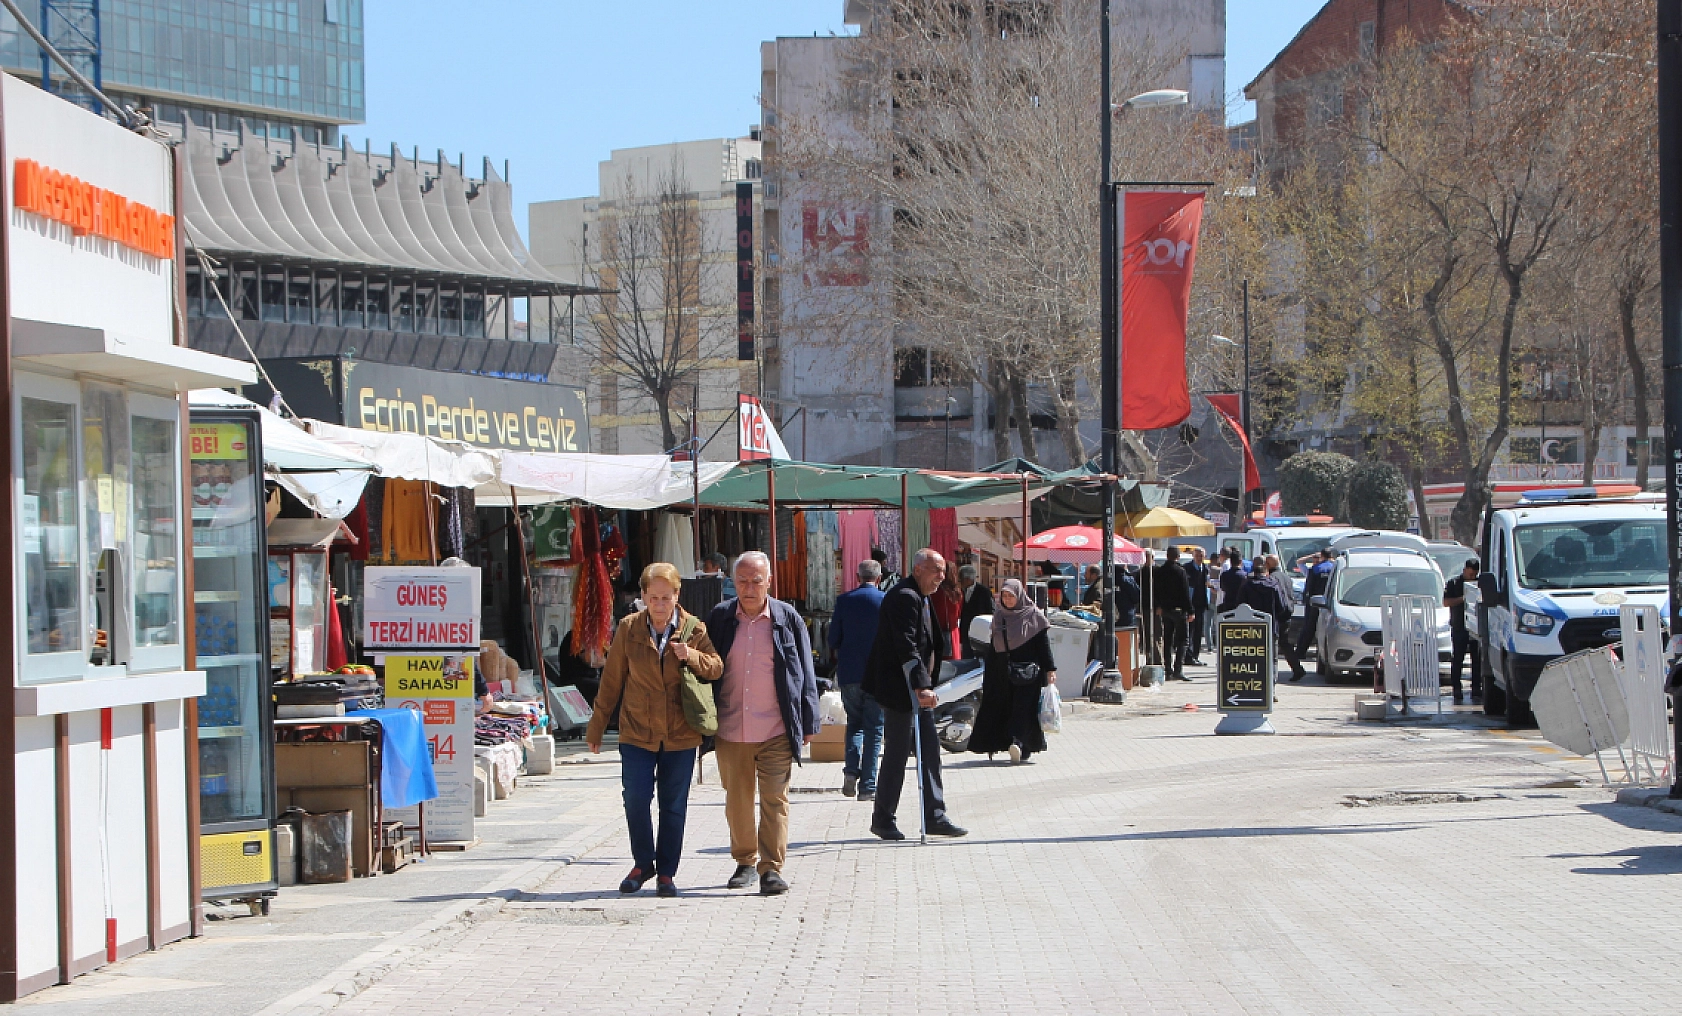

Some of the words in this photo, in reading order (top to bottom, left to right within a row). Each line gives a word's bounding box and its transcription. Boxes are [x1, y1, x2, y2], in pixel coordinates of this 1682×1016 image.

[359, 387, 419, 434] Ecrin
[422, 394, 489, 443] Perde
[492, 410, 520, 445] ve
[524, 406, 577, 455] Çeyiz
[191, 436, 219, 454] BE!
[396, 580, 448, 612] GÜNEŞ
[369, 617, 413, 642] TERZİ
[417, 618, 473, 644] HANESİ
[1225, 626, 1263, 639] ECRİN
[1223, 646, 1265, 657] PERDE
[1229, 663, 1258, 673] HALI
[398, 679, 459, 690] SAHASI
[1226, 679, 1263, 694] ÇEYİZ
[428, 733, 456, 760] 14
